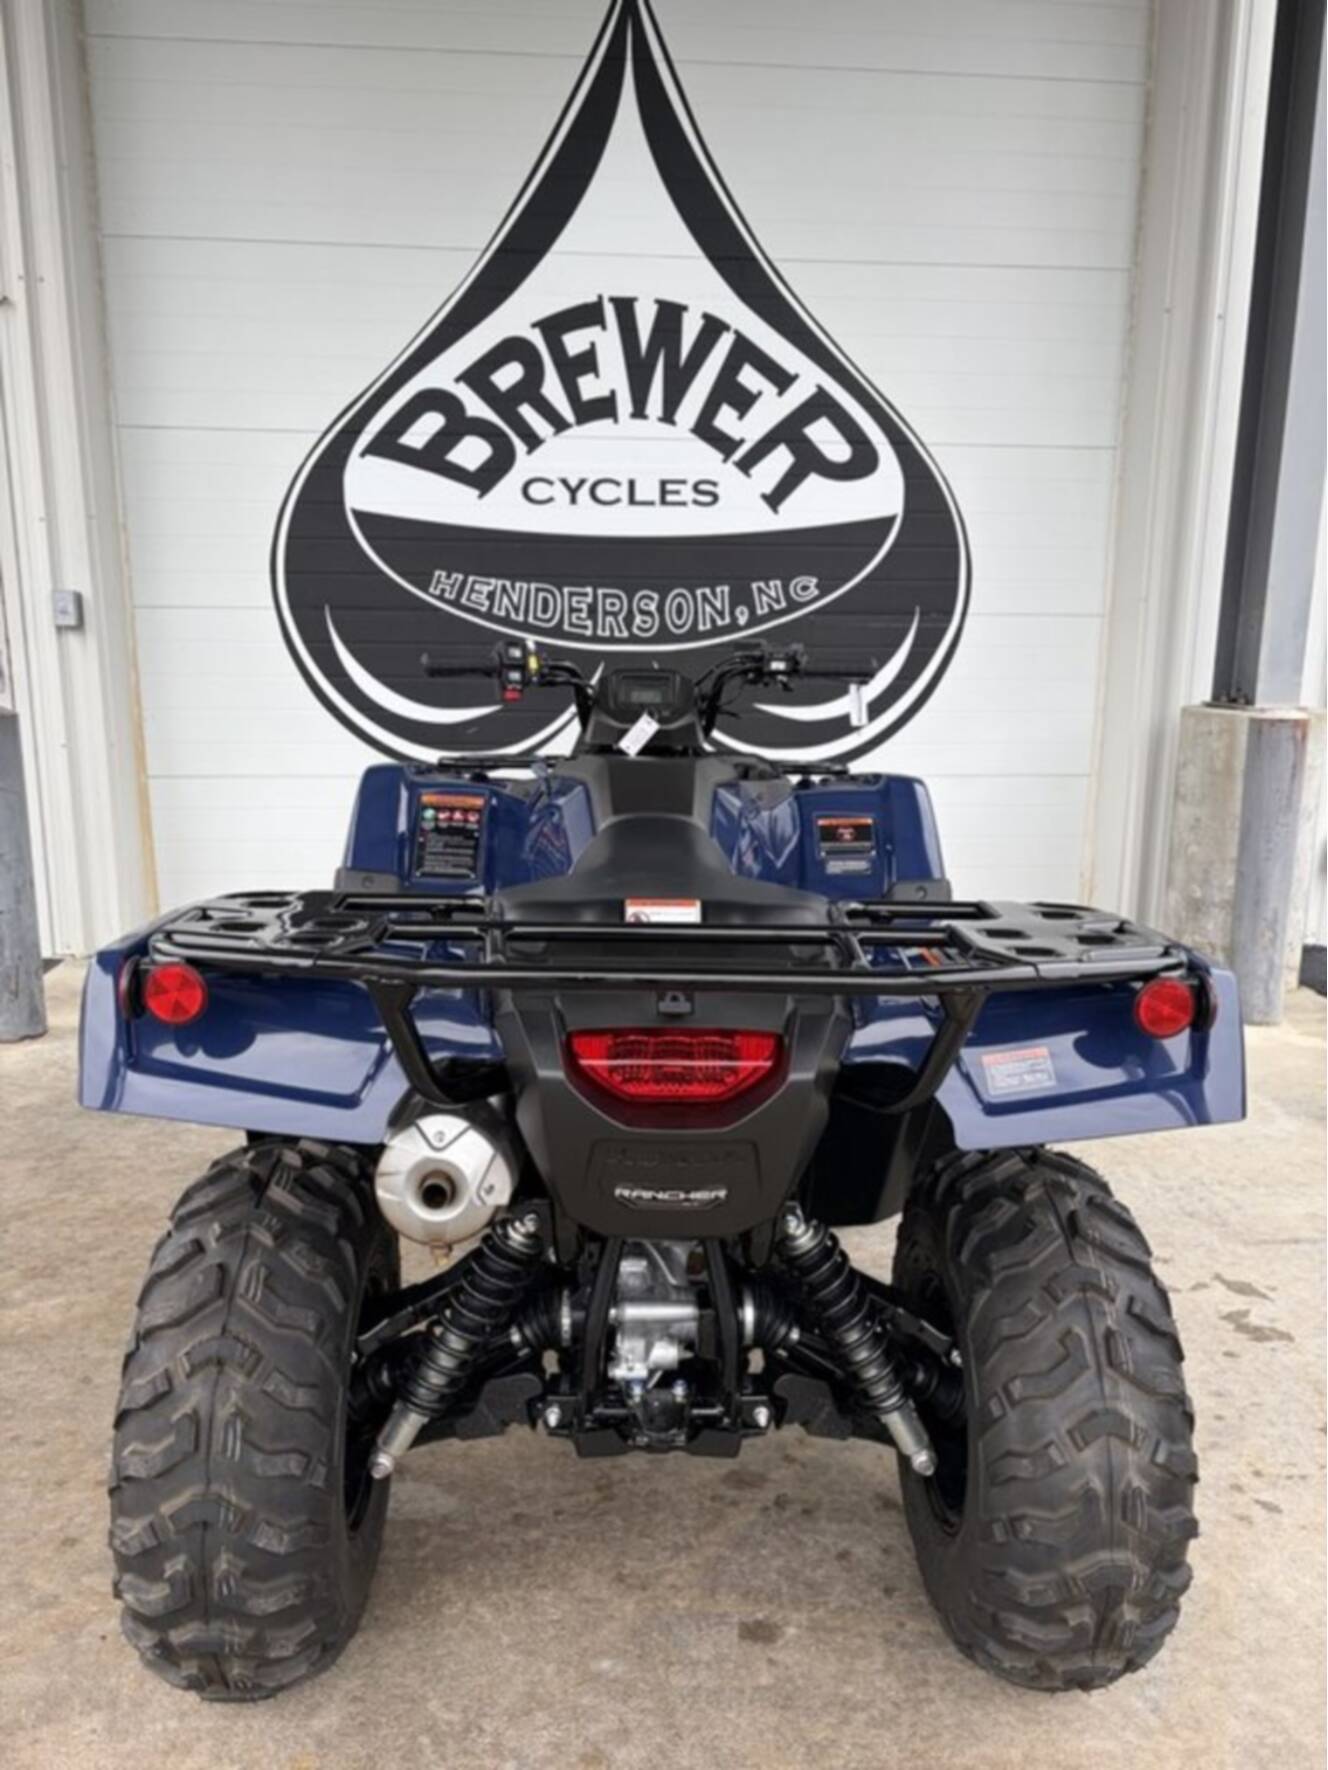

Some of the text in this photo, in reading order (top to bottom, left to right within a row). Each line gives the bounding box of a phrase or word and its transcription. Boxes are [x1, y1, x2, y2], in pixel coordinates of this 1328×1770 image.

[359, 294, 879, 514] BREWER
[521, 476, 720, 507] CYCLES
[613, 1187, 728, 1200] RANCHER
